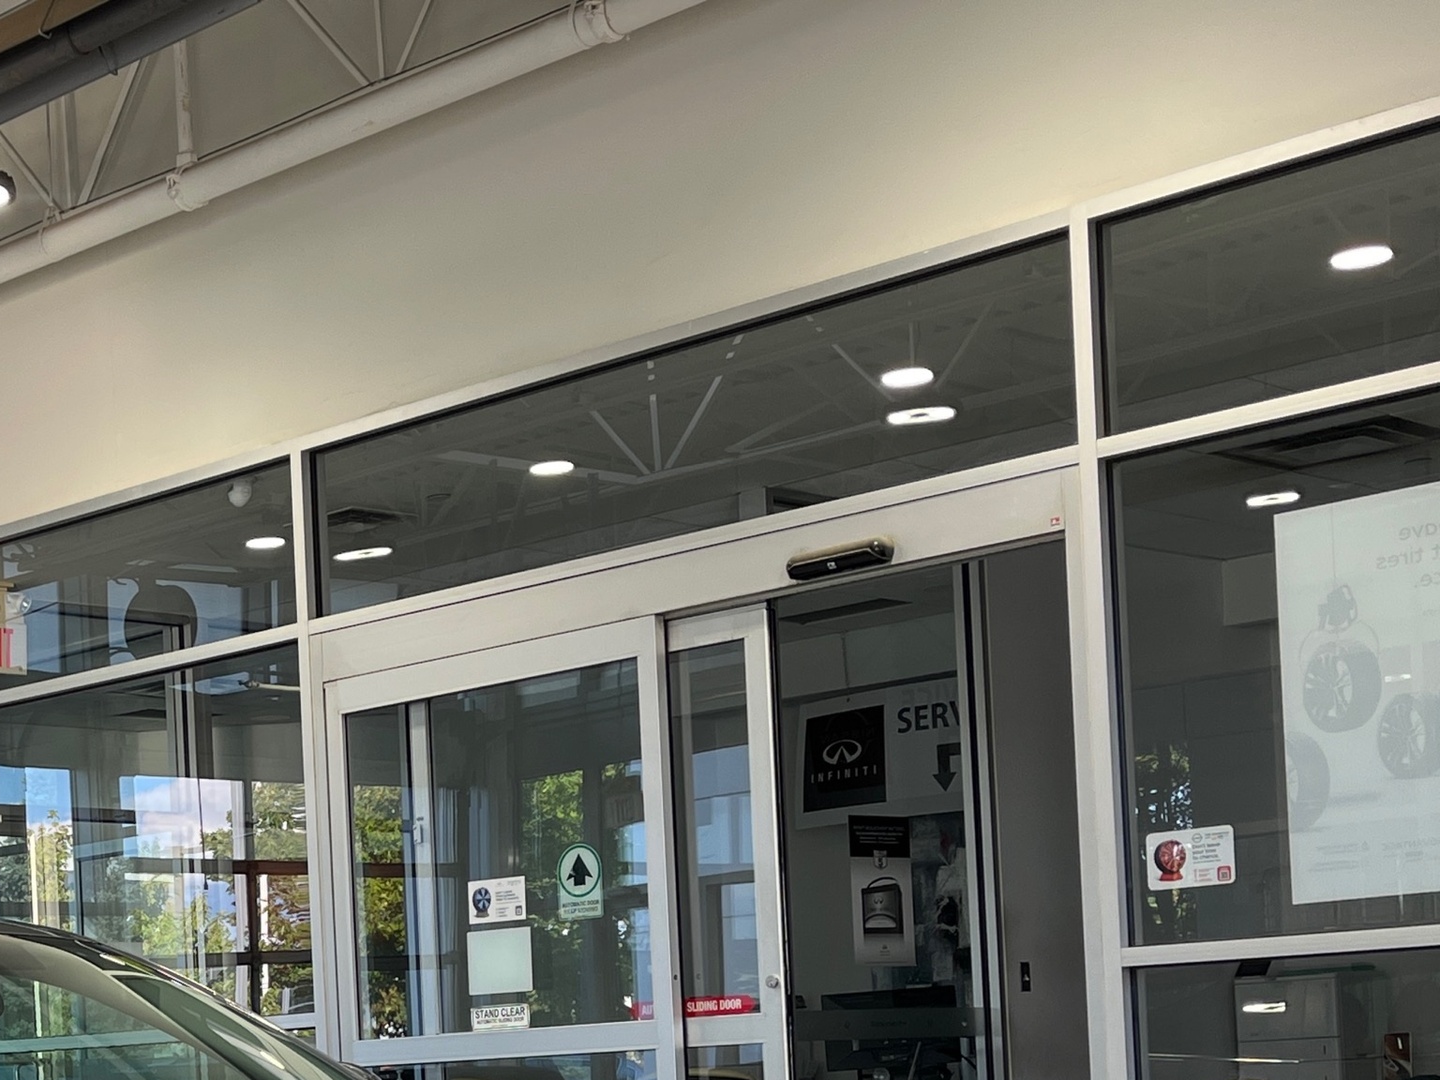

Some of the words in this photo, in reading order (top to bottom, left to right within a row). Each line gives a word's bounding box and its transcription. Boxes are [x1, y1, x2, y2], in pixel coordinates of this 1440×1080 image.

[810, 764, 878, 784] INFINITI
[686, 1000, 718, 1012] SLIDING
[719, 999, 742, 1011] DOOR
[475, 1008, 500, 1020] STAND
[500, 1006, 525, 1018] CLEAR
